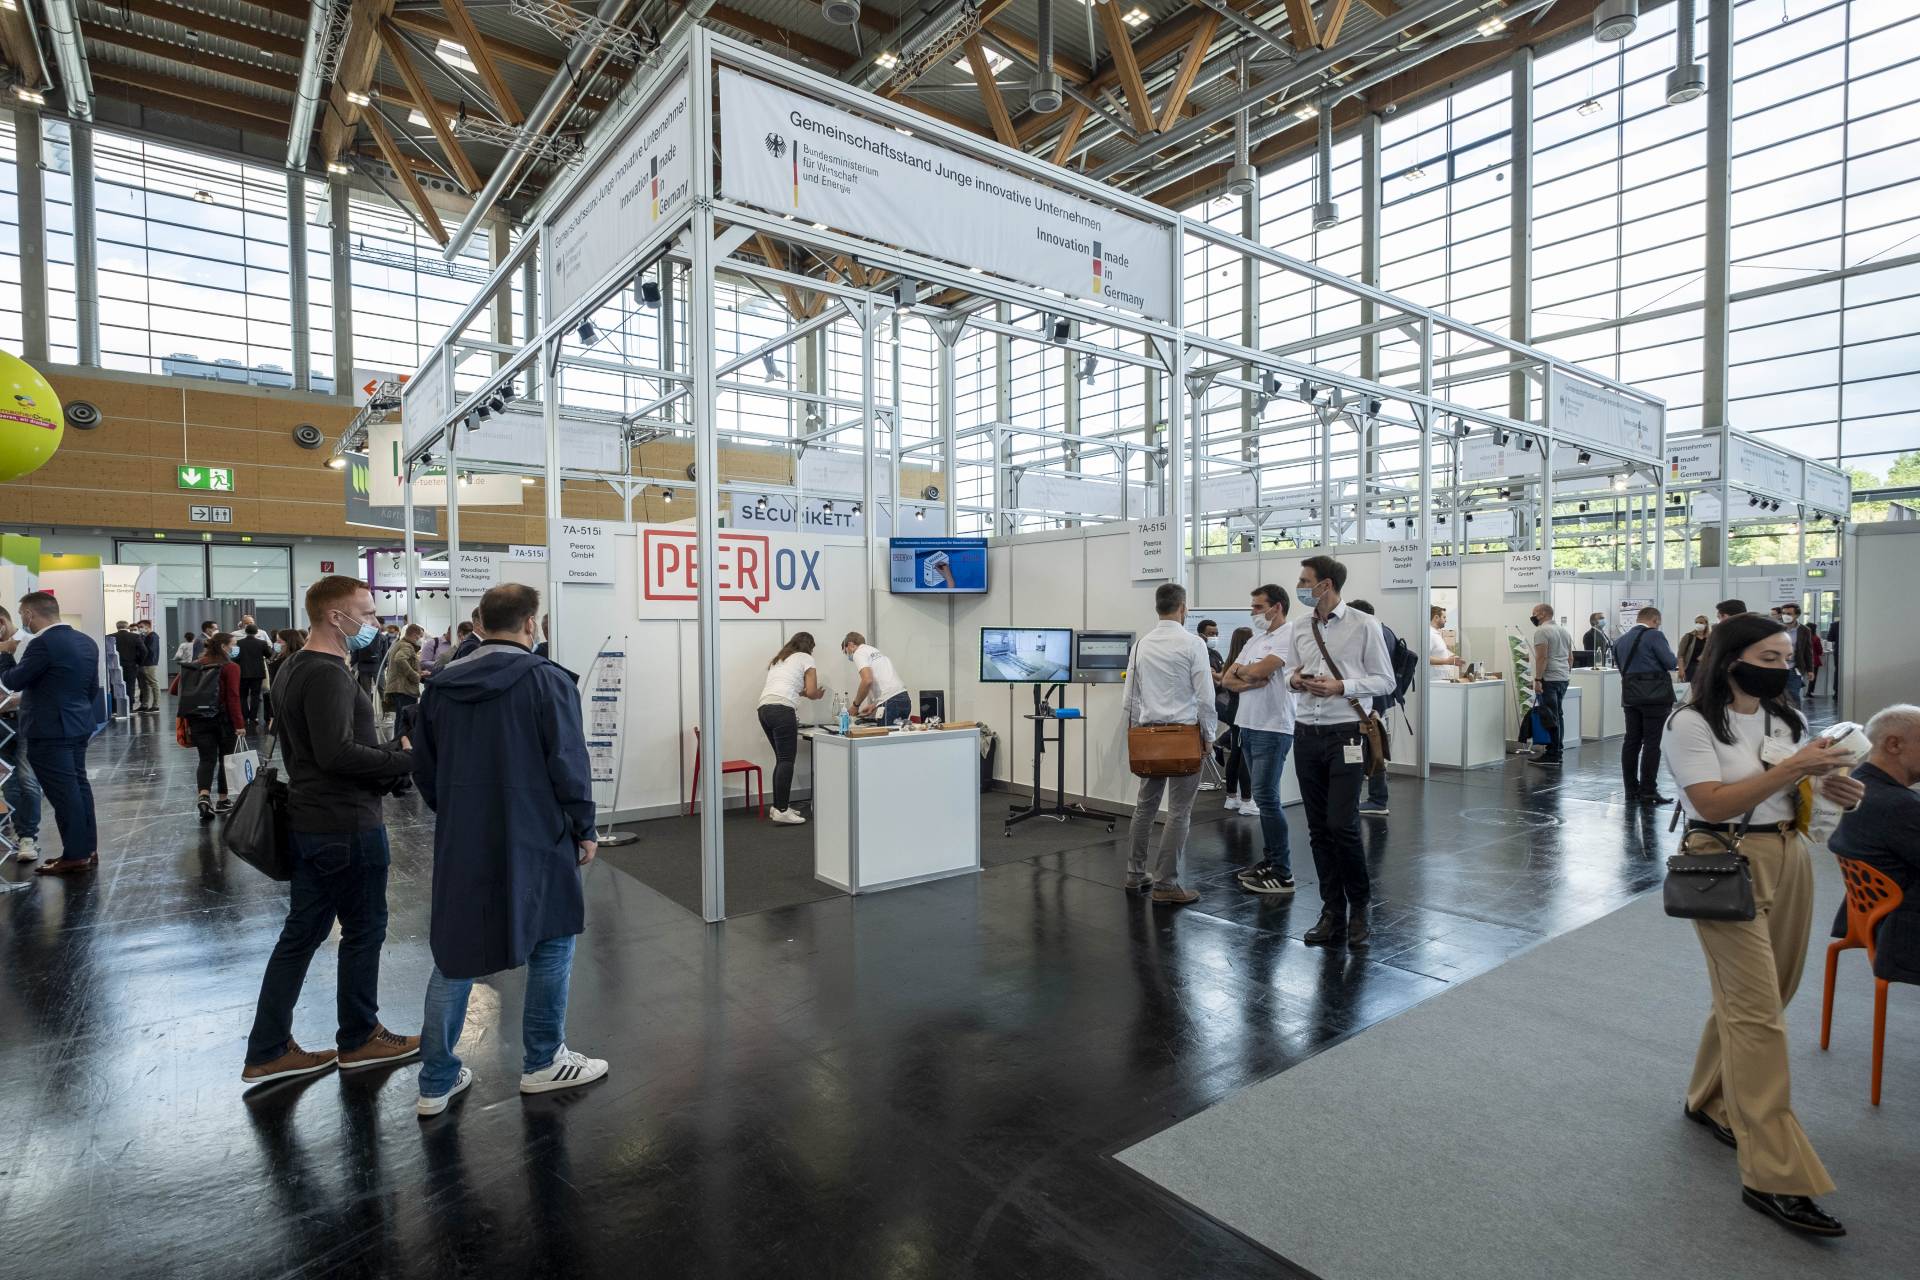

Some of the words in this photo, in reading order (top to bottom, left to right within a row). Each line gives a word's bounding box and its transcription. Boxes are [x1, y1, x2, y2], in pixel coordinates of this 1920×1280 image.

[643, 96, 688, 152] Unternehmen
[802, 143, 880, 178] Bundesministerium
[789, 110, 932, 173] Gemeinschaftsstand
[935, 162, 973, 187] Junge
[975, 175, 1032, 207] innovative
[1034, 197, 1102, 232] Unternehmen
[802, 156, 815, 169] für
[816, 161, 859, 184] Wirtschaft
[619, 172, 649, 210] Innovation
[658, 143, 677, 172] made
[802, 172, 819, 184] und
[821, 174, 851, 195] Energie
[658, 178, 689, 215] Germany
[1036, 226, 1090, 255] Innovation
[1104, 251, 1130, 268] made
[1104, 268, 1113, 281] in
[1104, 286, 1145, 309] Germany
[1680, 470, 1712, 479] Germany
[562, 525, 601, 536] 7A-515i
[1138, 522, 1167, 533] 7A-515i
[569, 542, 595, 550] Peerox
[1388, 544, 1418, 553] 7A-515h
[460, 555, 490, 564] 7A-515j
[514, 549, 544, 558] 7A-515i
[571, 551, 595, 559] GmbH
[1512, 554, 1541, 562] 7A-515g
[1433, 560, 1457, 568] 7A-515h
